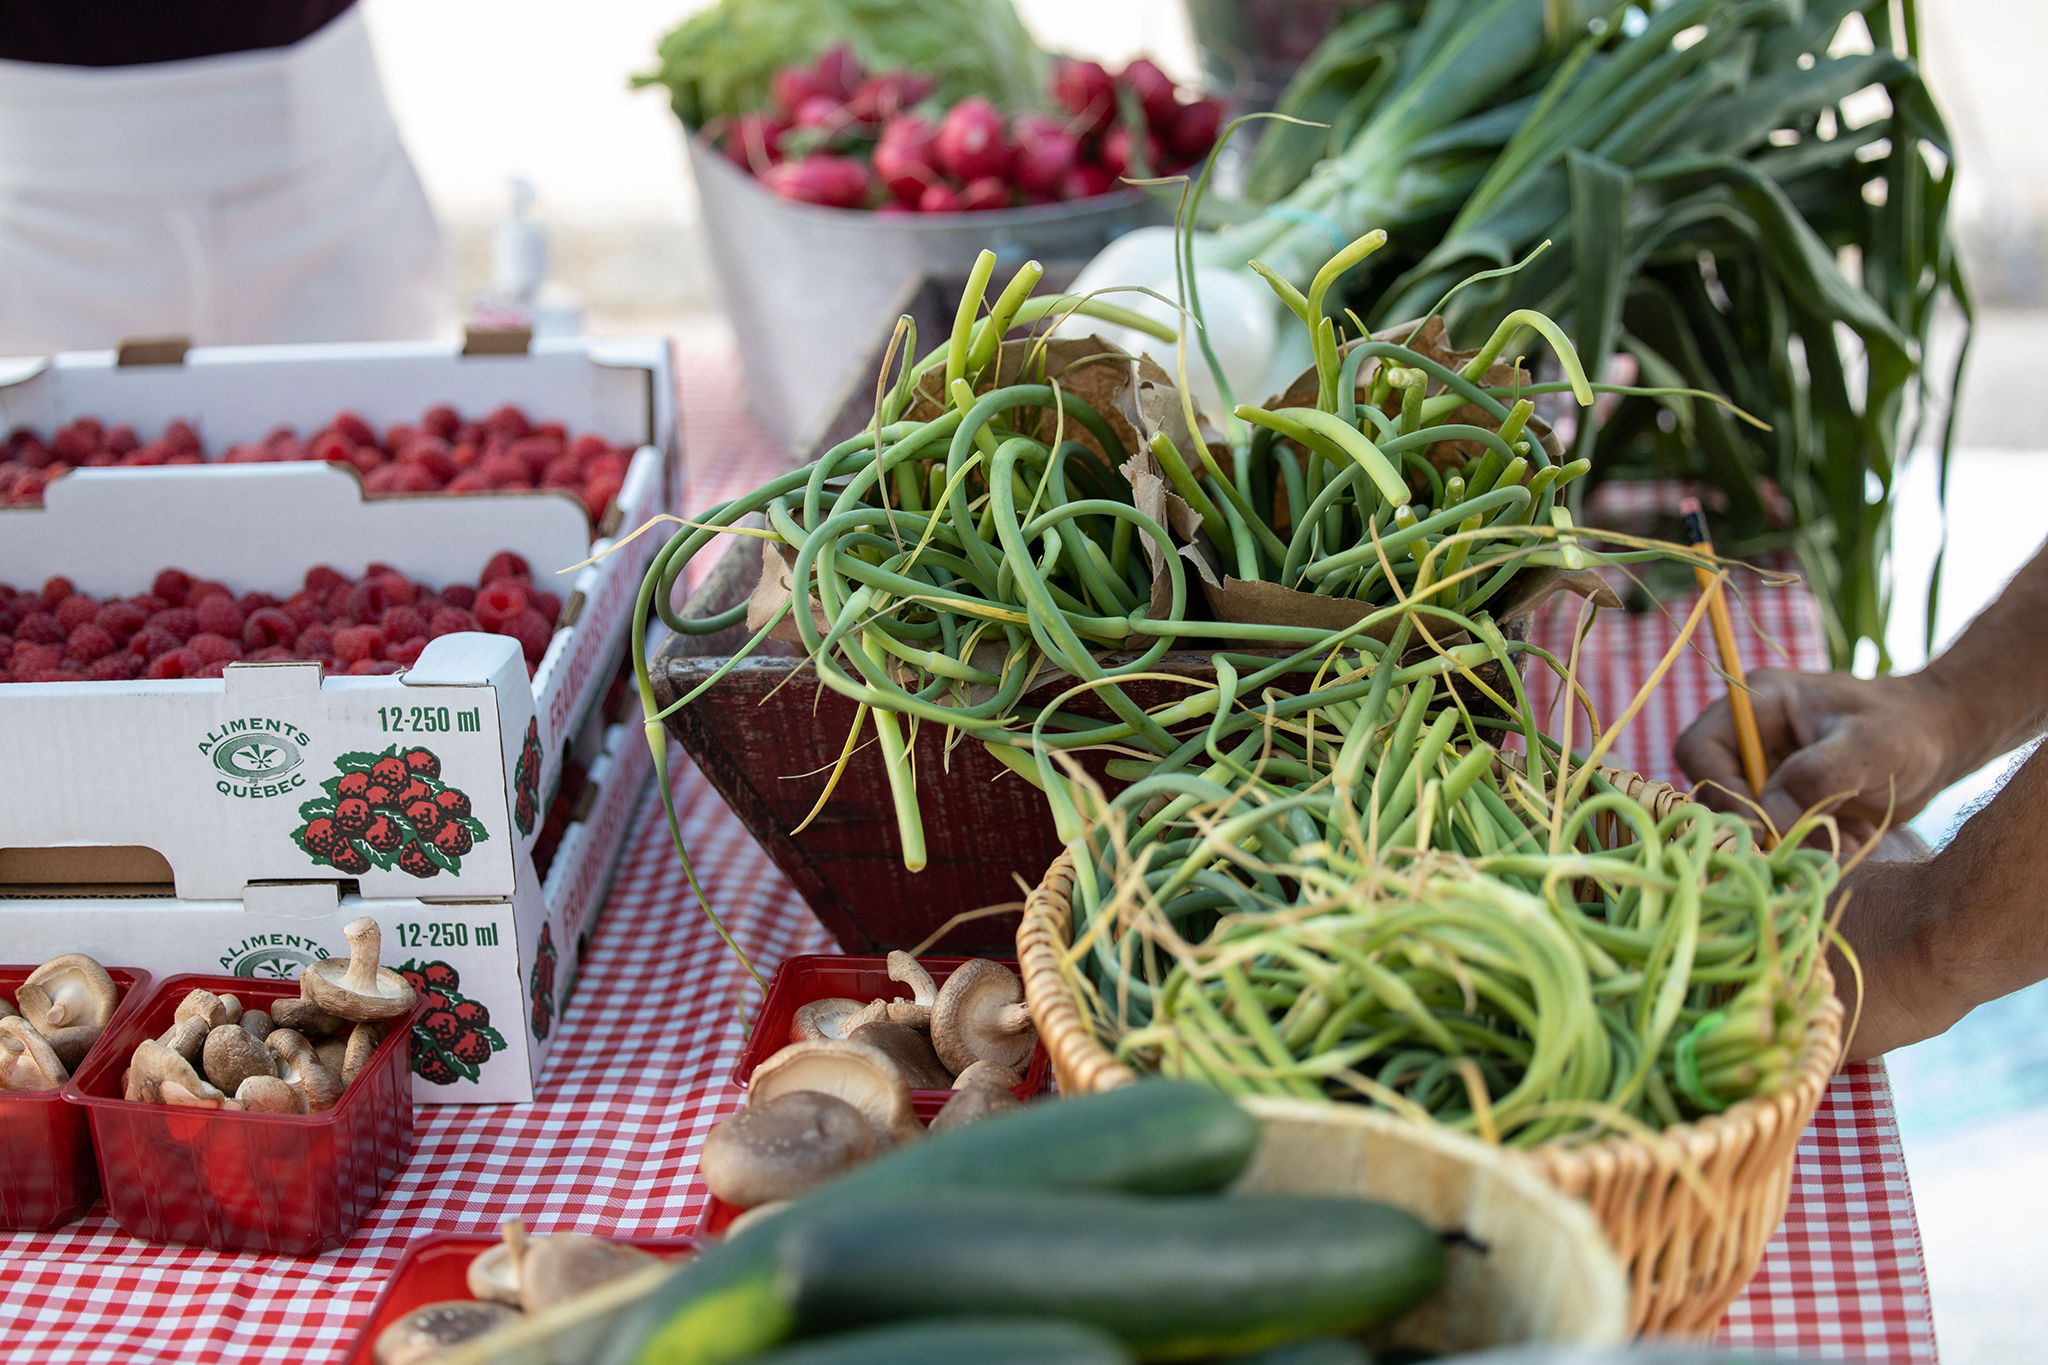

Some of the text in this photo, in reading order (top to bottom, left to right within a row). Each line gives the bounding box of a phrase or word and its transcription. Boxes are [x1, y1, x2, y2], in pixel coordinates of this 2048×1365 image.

[378, 707, 481, 732] 12-250 ml
[198, 717, 311, 756] ALIMENTS
[216, 773, 306, 799] QUÉBEC
[396, 922, 499, 947] 12-250 ml
[219, 933, 331, 970] ALIMENTS
